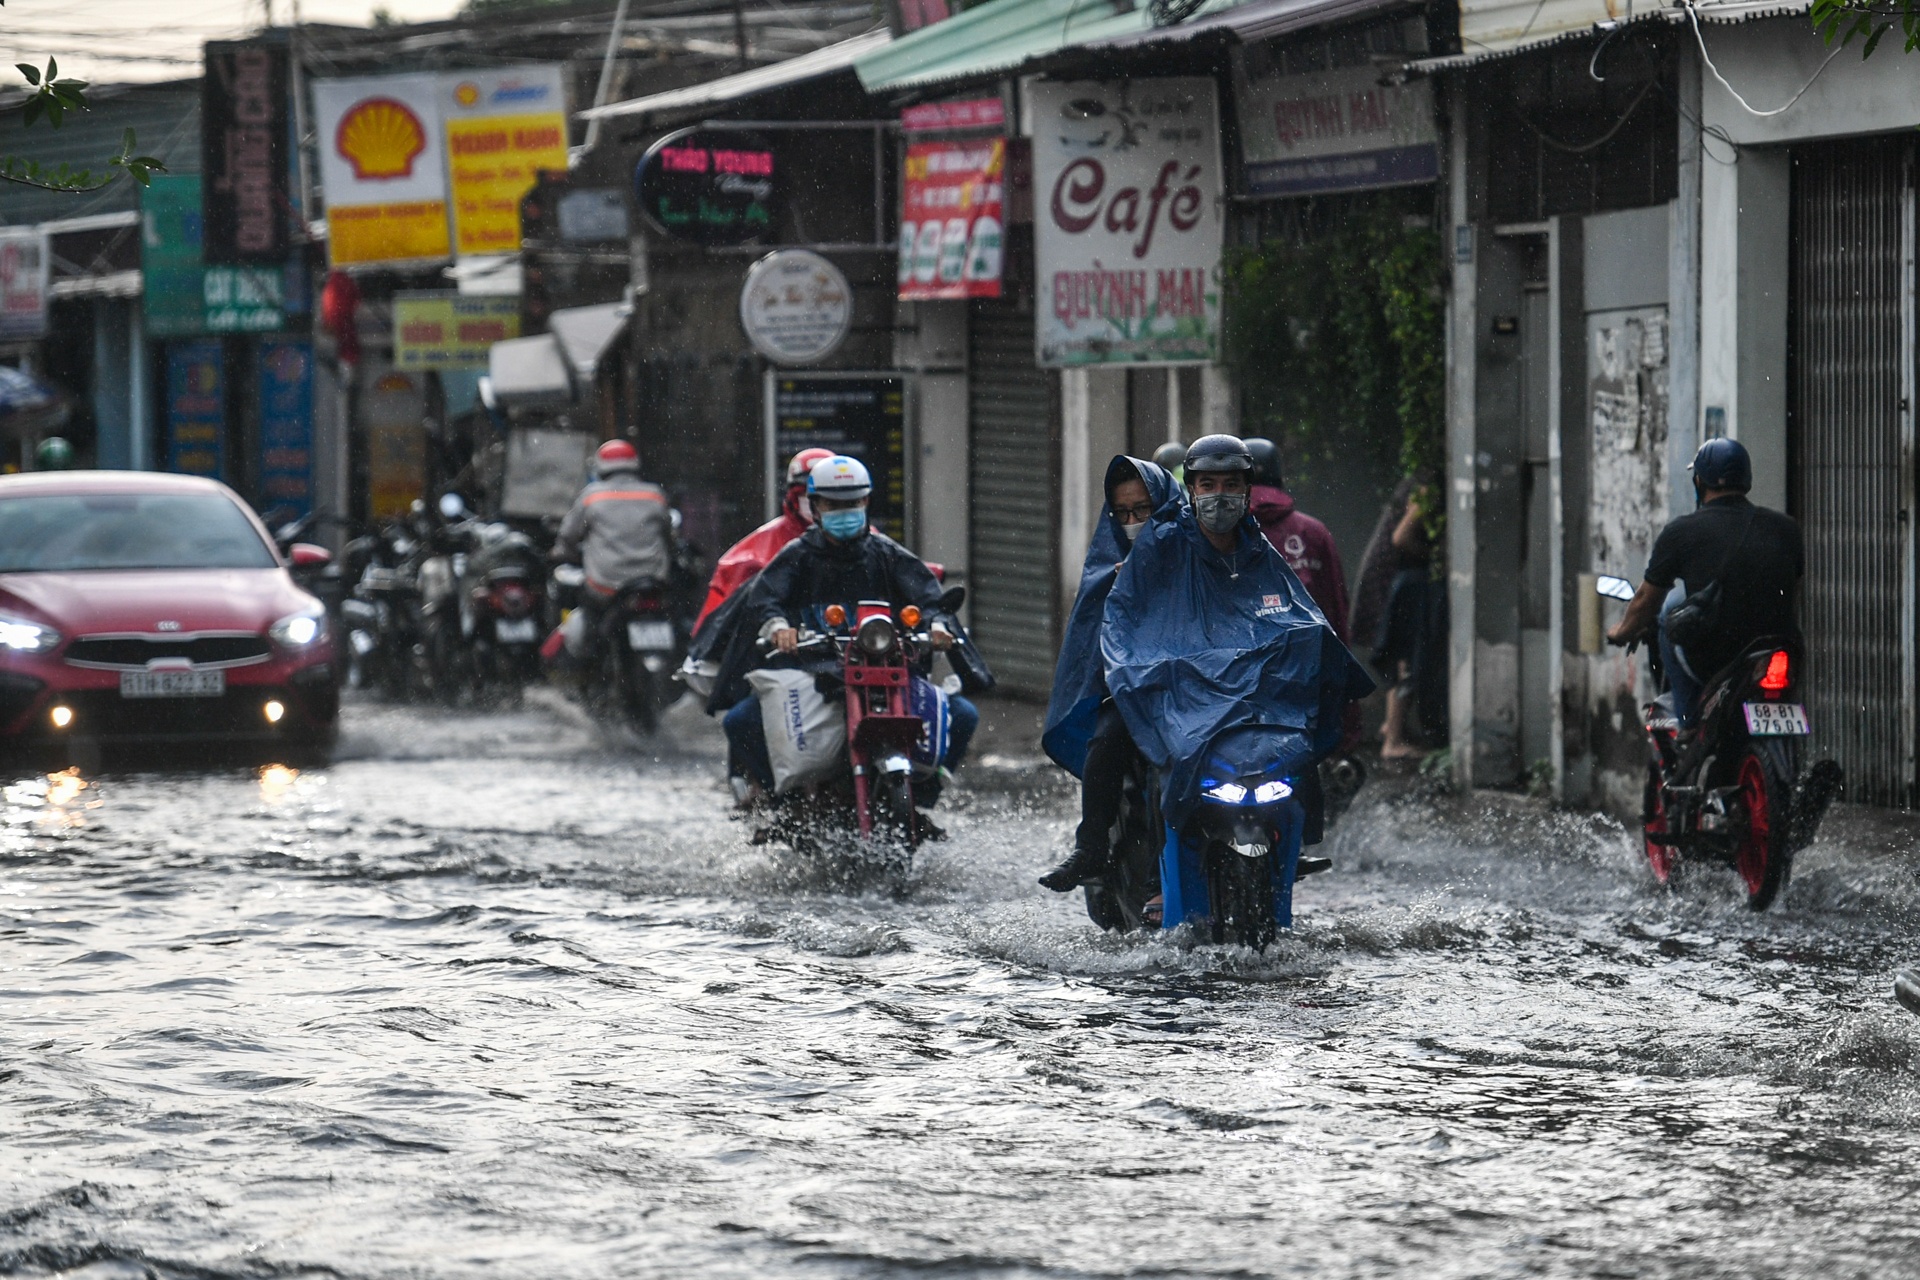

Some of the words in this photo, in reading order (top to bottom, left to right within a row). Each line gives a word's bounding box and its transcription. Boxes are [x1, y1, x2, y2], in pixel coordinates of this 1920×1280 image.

[1052, 157, 1202, 259] Café
[1055, 259, 1149, 329] QUỲNH
[1156, 267, 1205, 318] MAI
[788, 688, 808, 751] HYOSUNG
